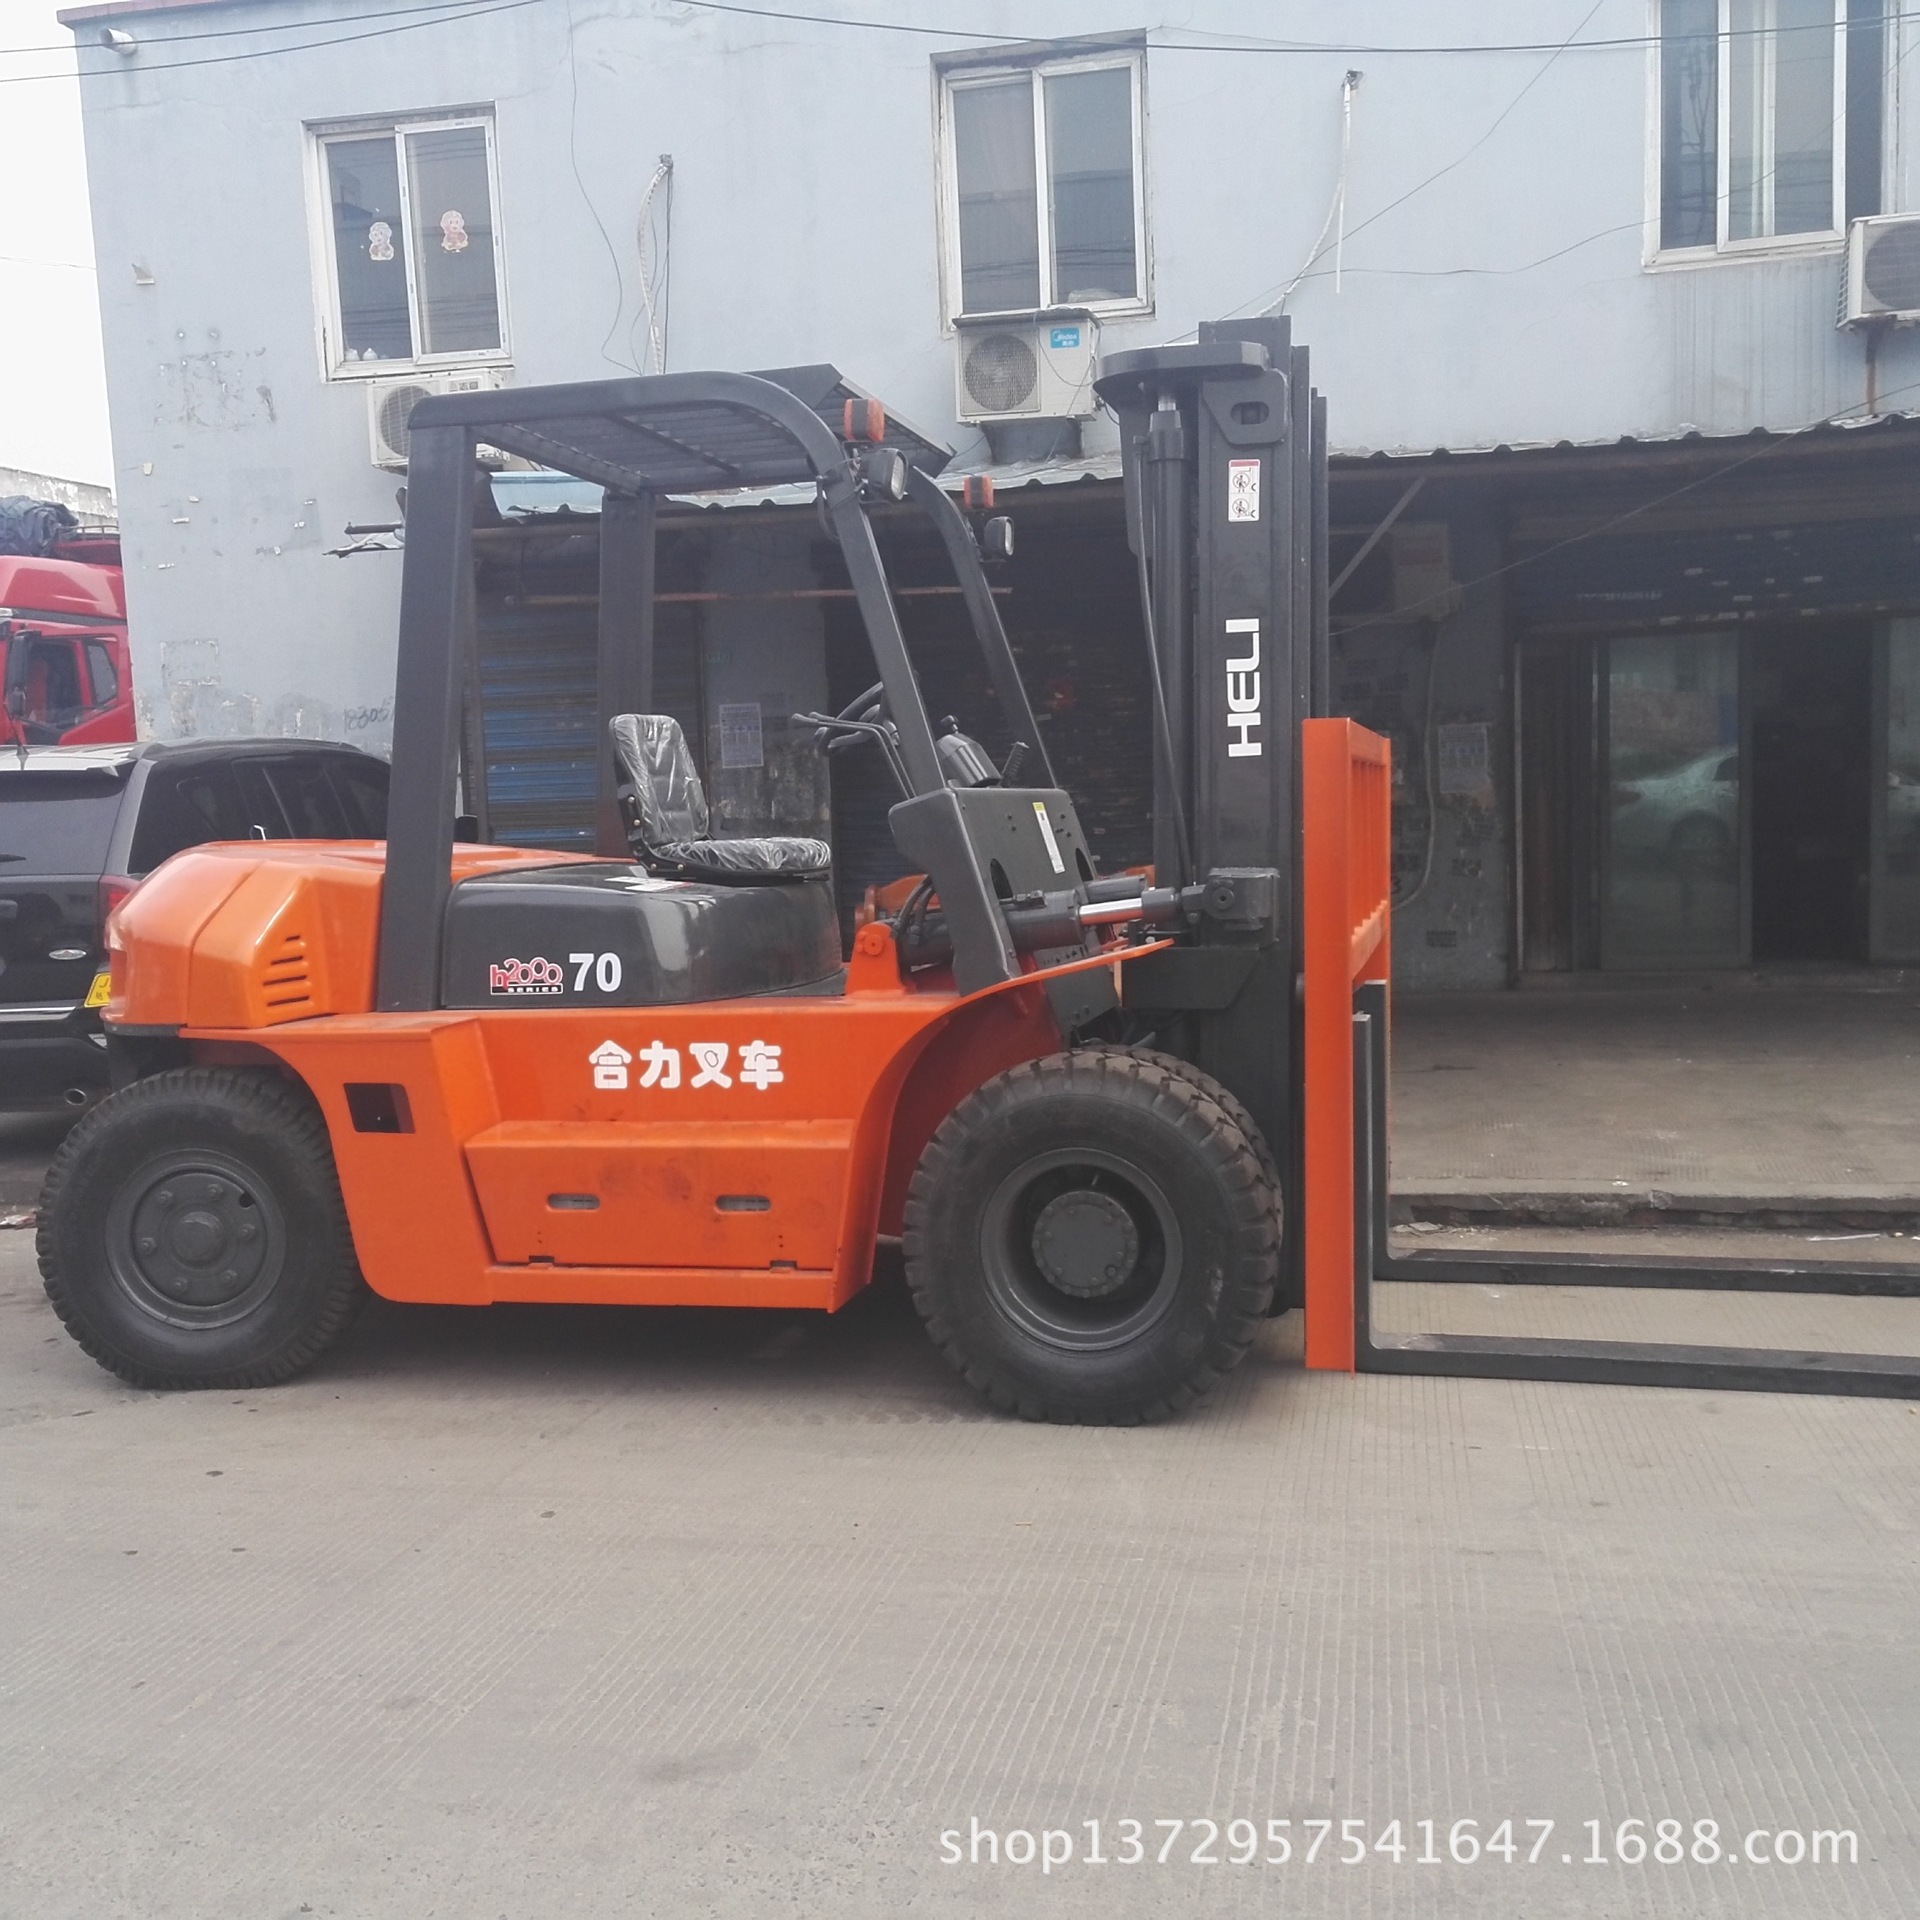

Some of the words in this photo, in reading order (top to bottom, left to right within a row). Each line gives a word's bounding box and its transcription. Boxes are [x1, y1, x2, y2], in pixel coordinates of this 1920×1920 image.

[1226, 618, 1262, 758] HELI
[569, 952, 622, 992] 70
[589, 1040, 784, 1090] 合力叉车
